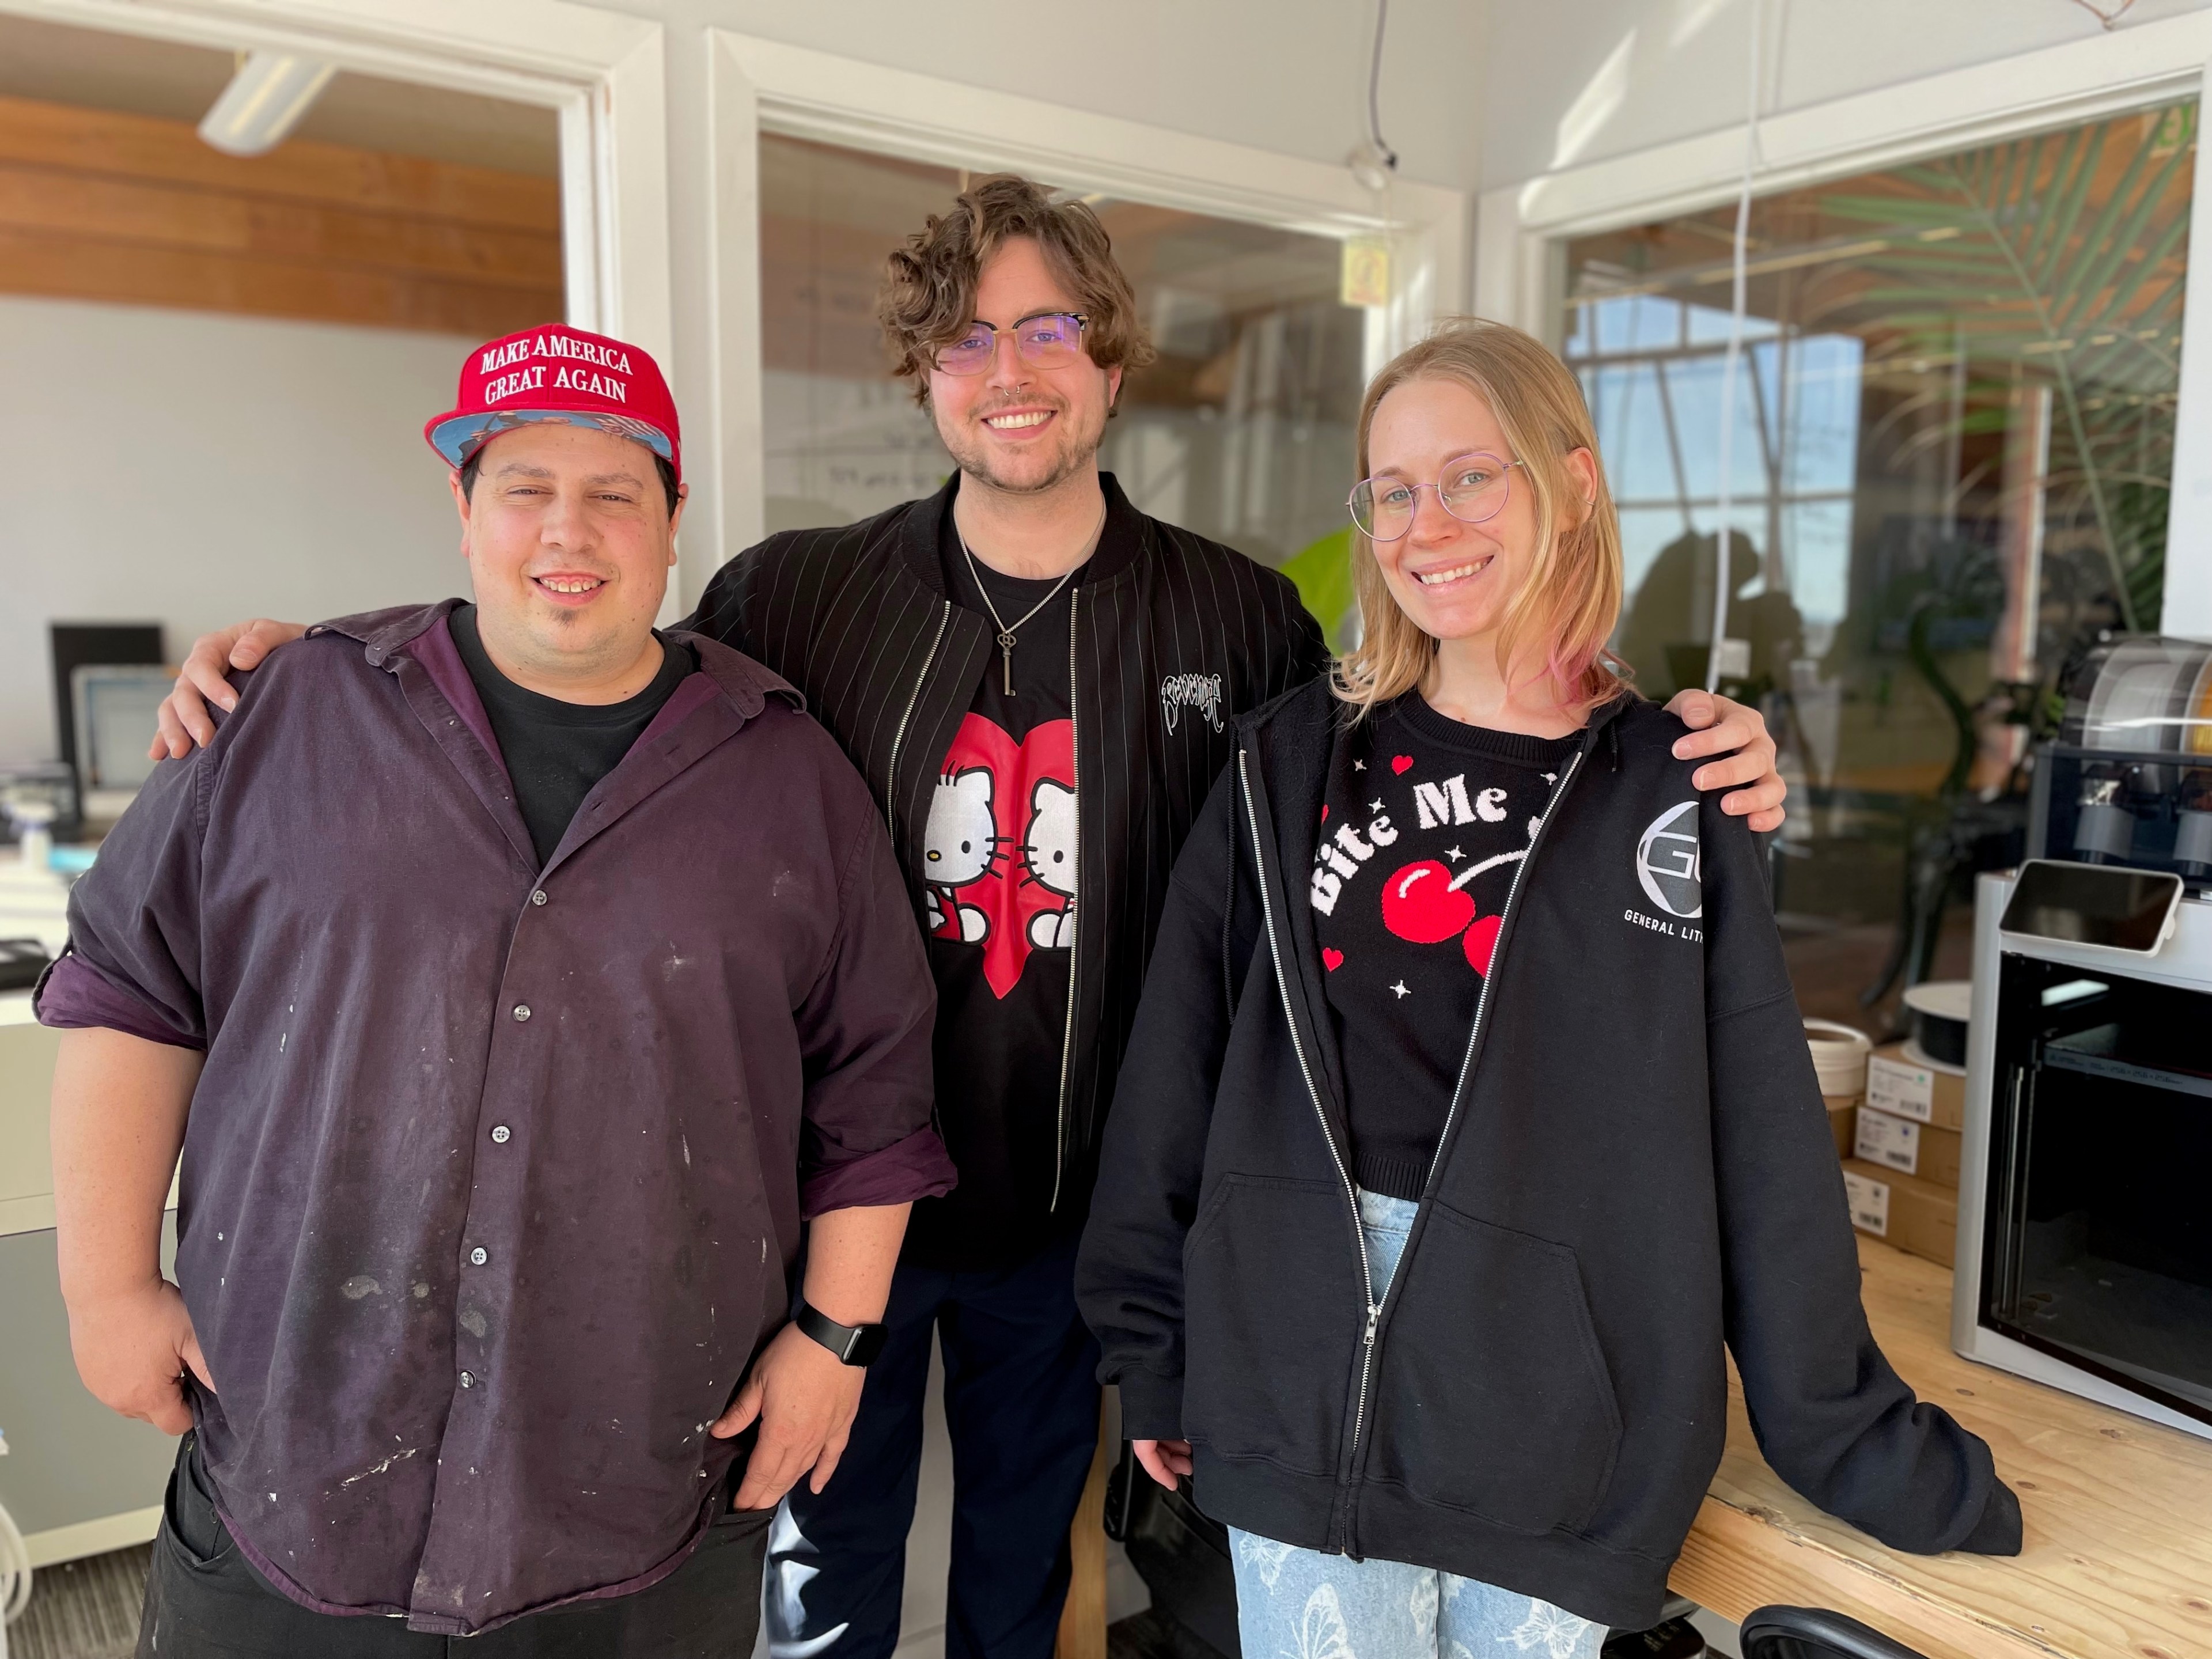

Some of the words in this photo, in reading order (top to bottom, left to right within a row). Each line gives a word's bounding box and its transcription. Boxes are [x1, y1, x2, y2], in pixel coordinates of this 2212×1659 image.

[480, 339, 530, 375] MAKE
[531, 335, 634, 376] AMERICA
[485, 366, 546, 405] GREAT
[553, 366, 626, 404] AGAIN
[1310, 815, 1399, 916] Bite
[1413, 773, 1508, 830] Me
[1624, 909, 1675, 935] GENERAL
